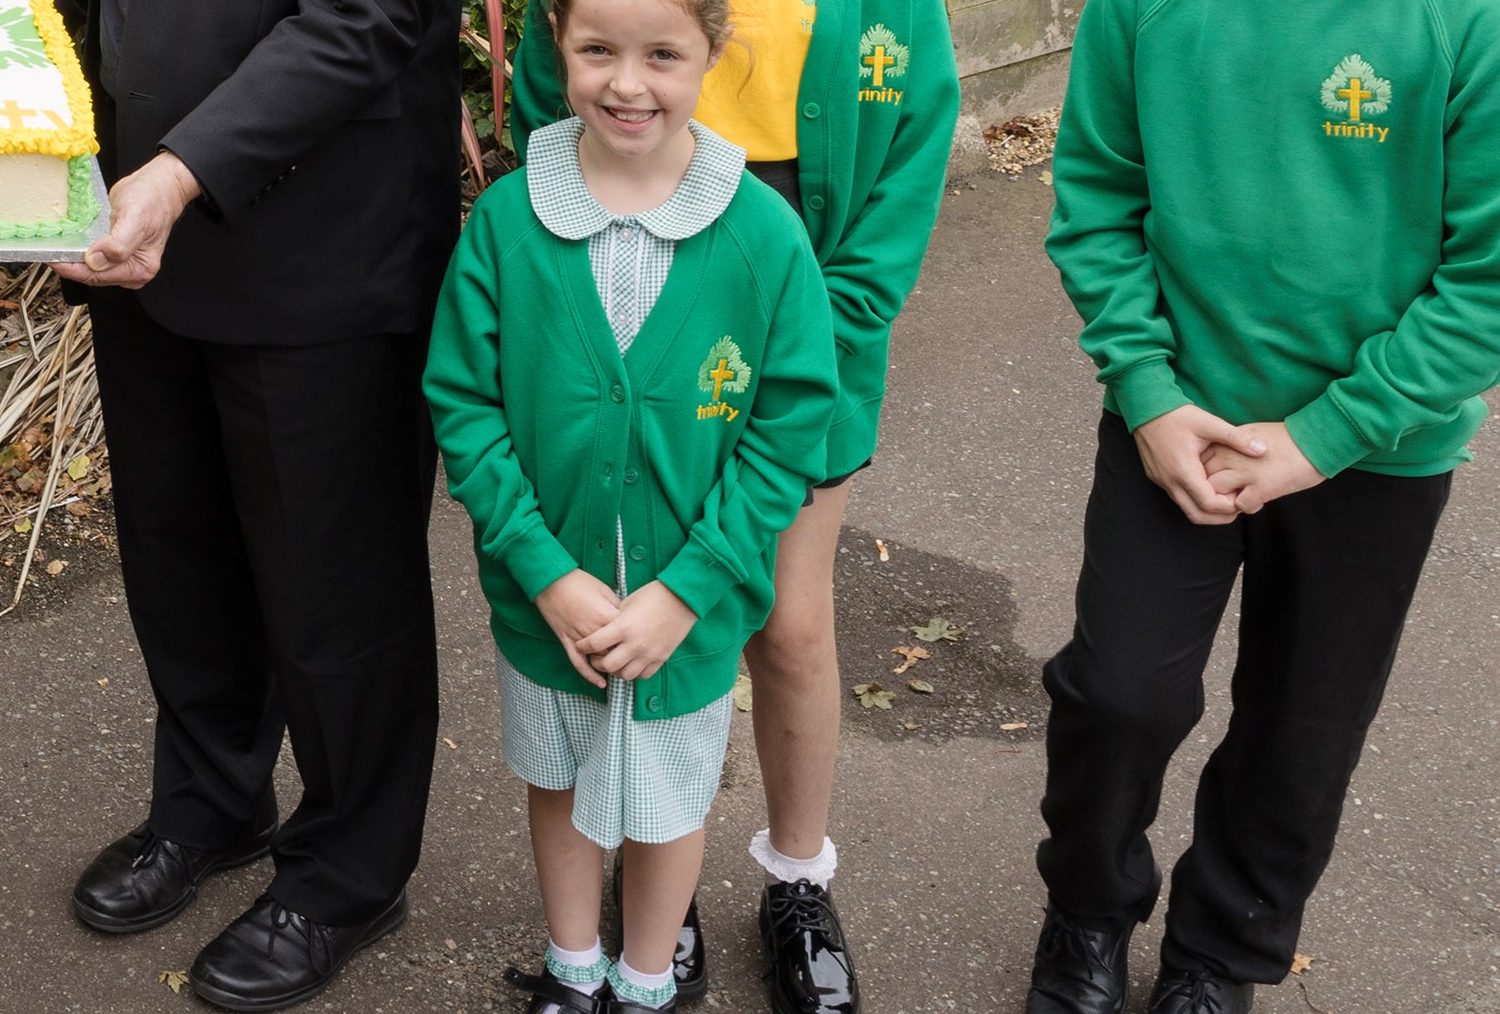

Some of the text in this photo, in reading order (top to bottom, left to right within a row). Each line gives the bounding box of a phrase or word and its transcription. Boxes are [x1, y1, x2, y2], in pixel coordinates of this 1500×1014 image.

[858, 87, 903, 106] rinity
[1322, 121, 1389, 143] trinity
[696, 401, 740, 422] trinity
